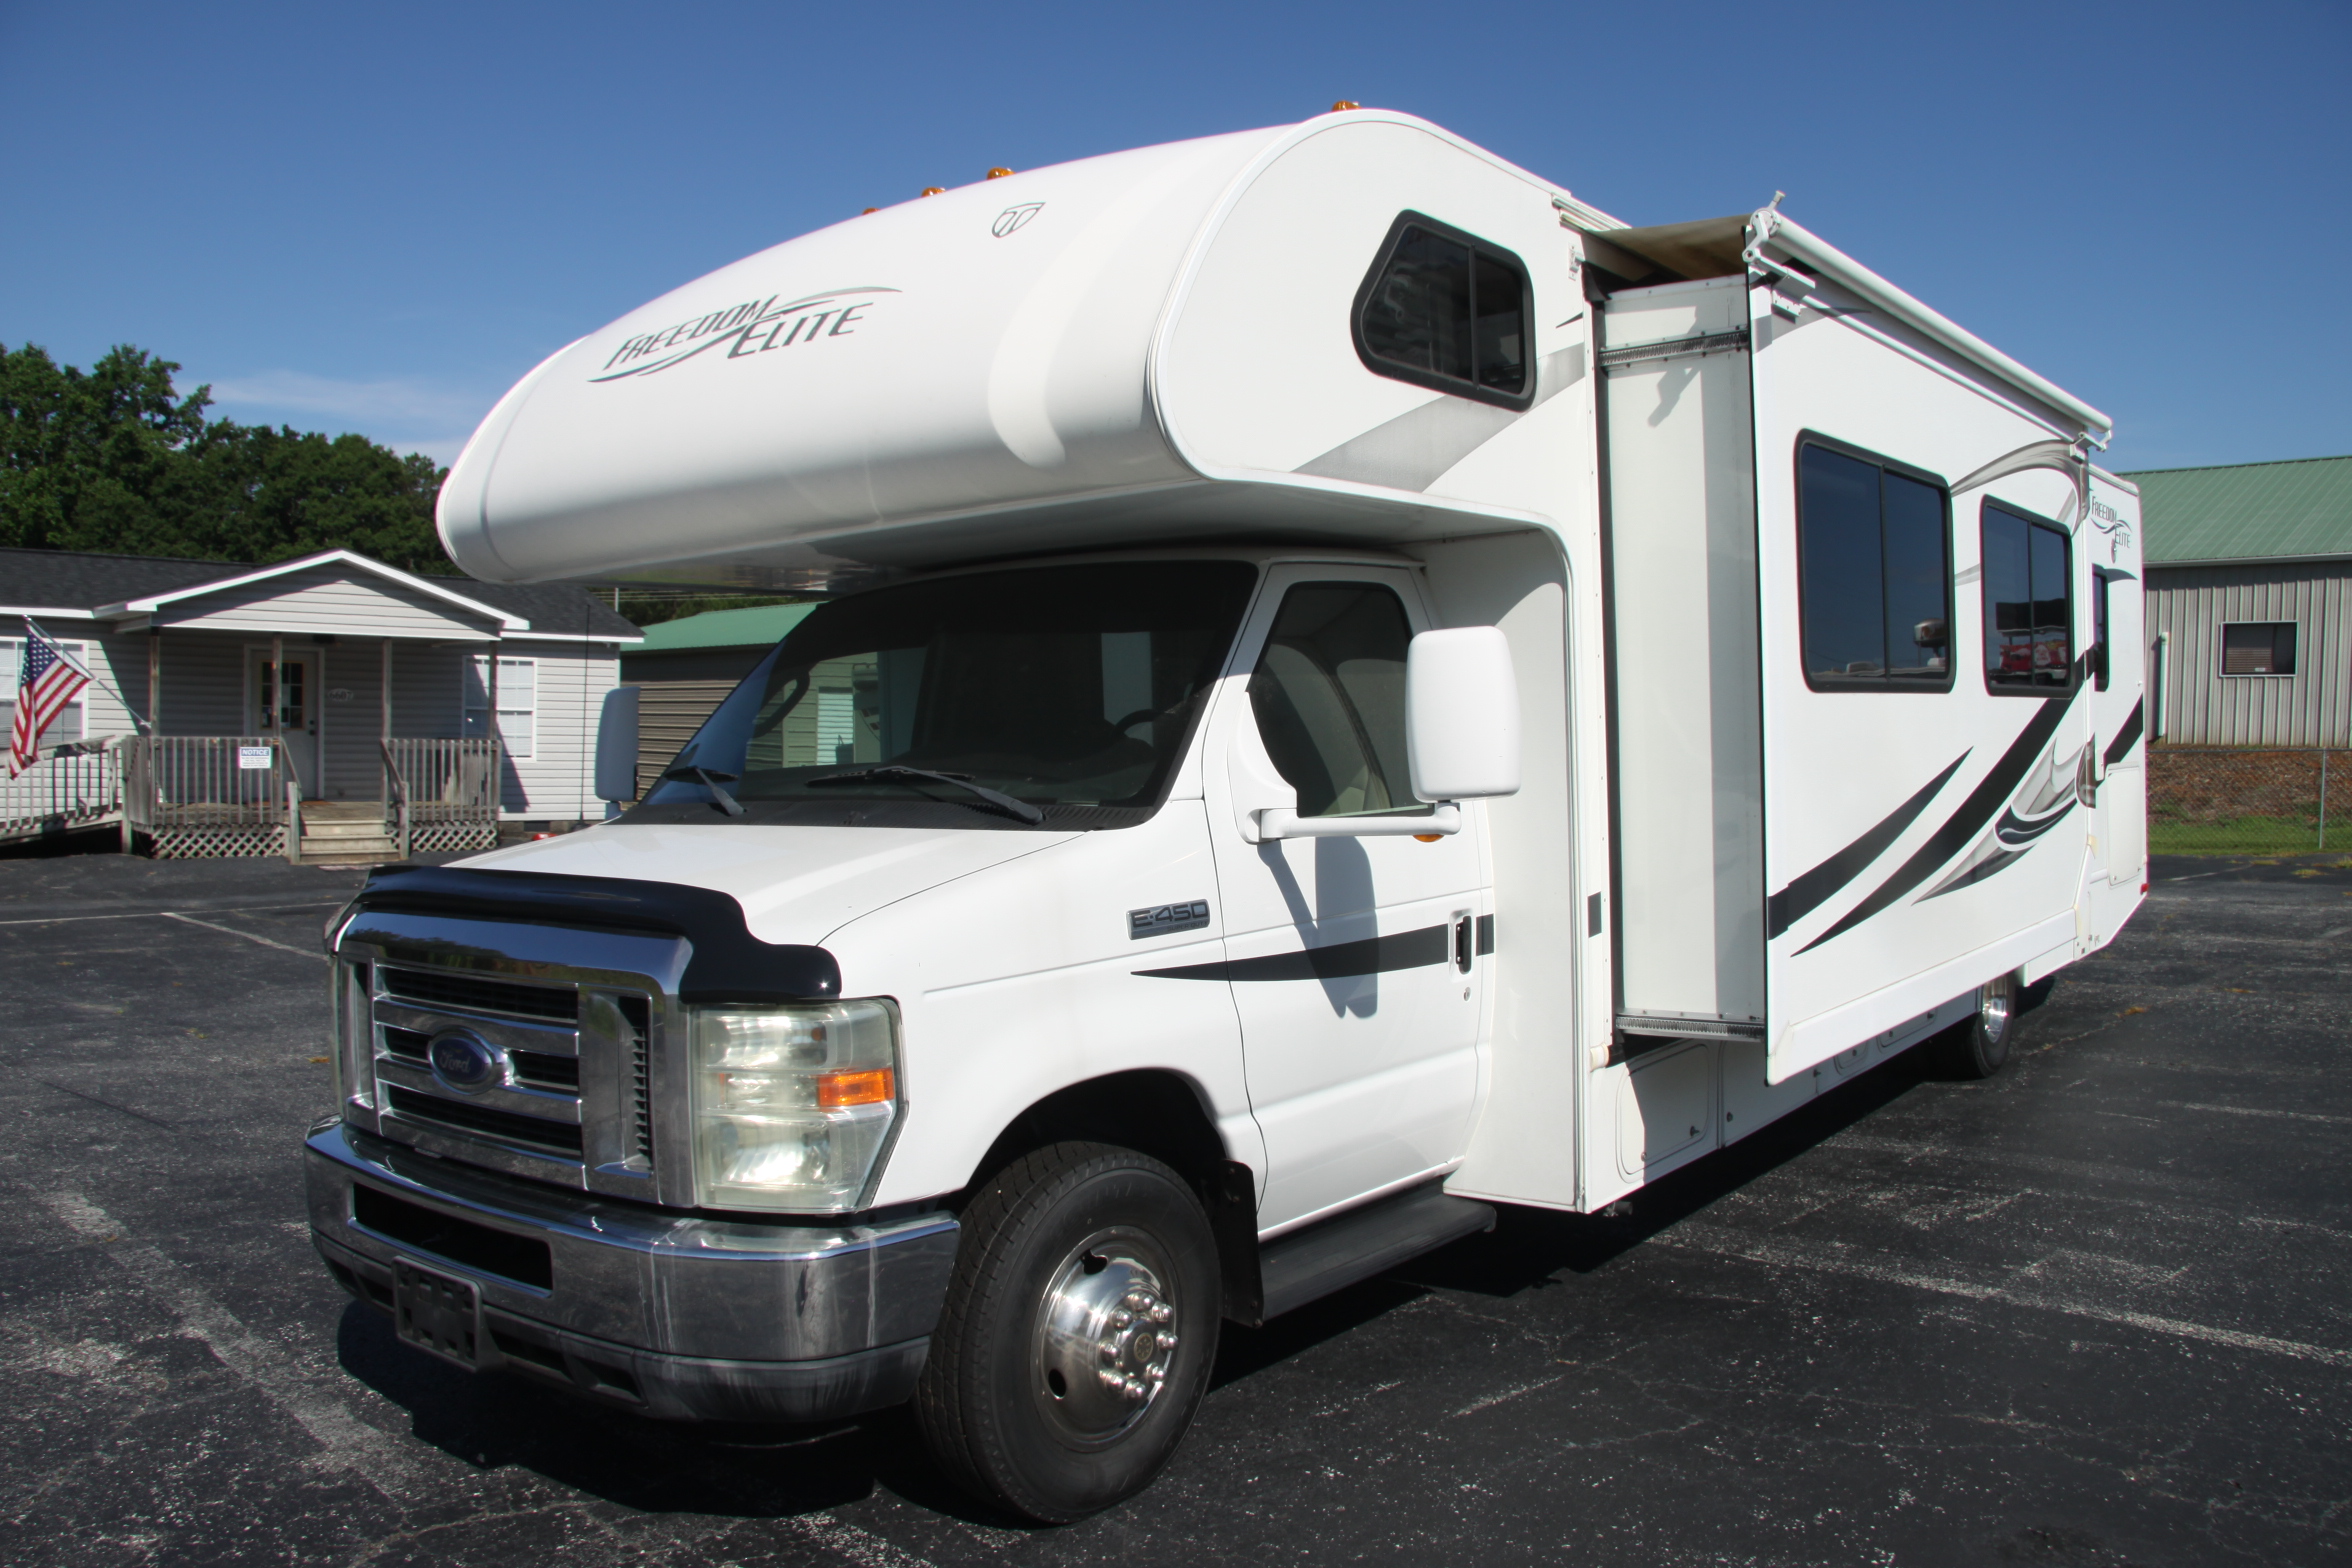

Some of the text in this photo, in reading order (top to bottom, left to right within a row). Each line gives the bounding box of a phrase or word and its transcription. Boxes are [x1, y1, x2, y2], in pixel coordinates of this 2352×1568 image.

[602, 294, 780, 371] FREEDOM
[727, 302, 874, 359] ELITE
[2092, 495, 2117, 524] FREEDOM
[2115, 528, 2131, 549] ELITE
[439, 1049, 471, 1073] Ford
